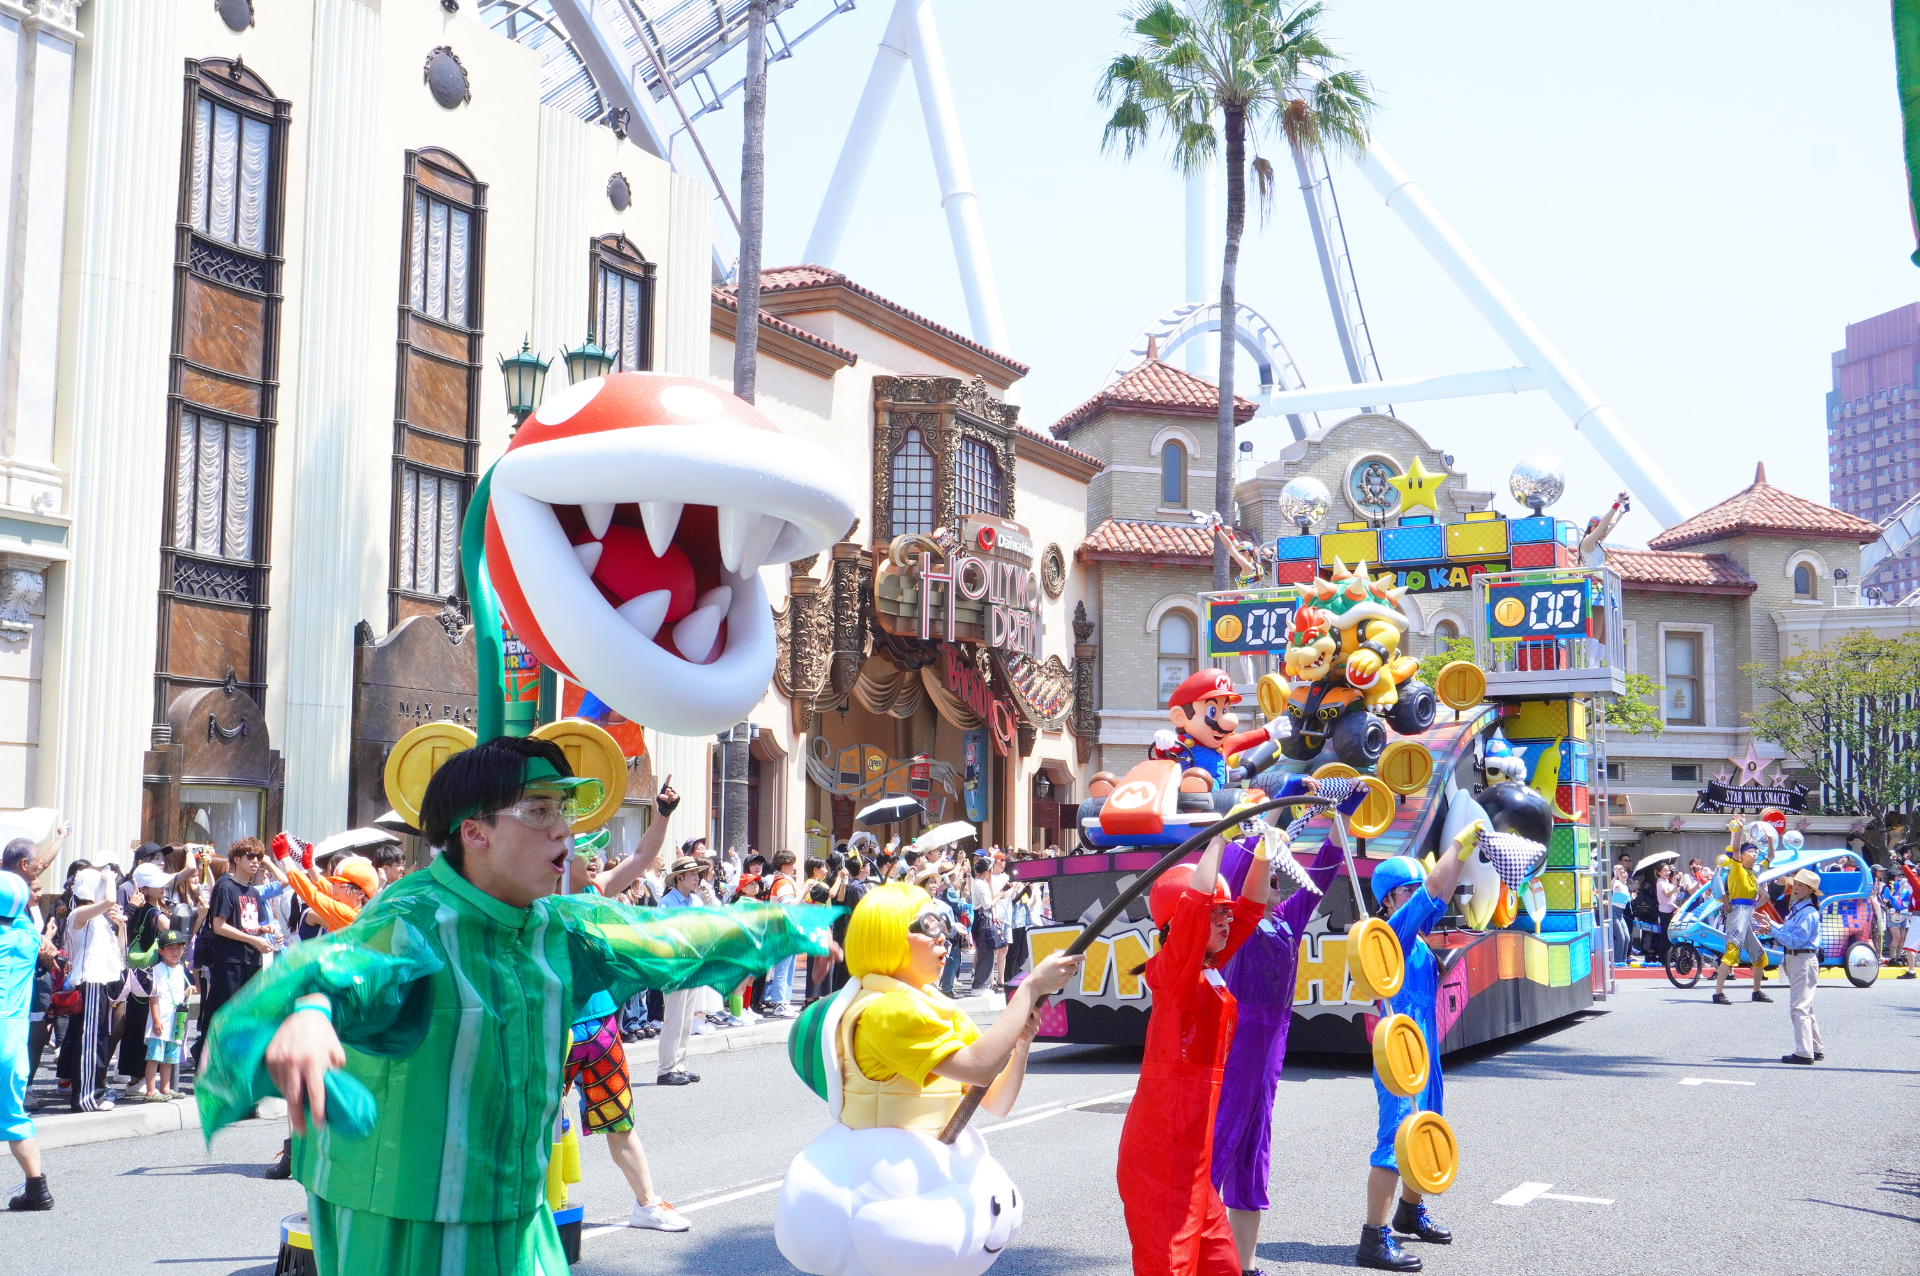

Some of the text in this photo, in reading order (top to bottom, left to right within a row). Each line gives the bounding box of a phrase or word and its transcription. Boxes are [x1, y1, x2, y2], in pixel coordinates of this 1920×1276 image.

[1529, 589, 1582, 630] 00
[991, 604, 1039, 656] DREAM
[398, 700, 478, 723] MAX FAC
[1725, 789, 1791, 806] STAR WALK SNACKS
